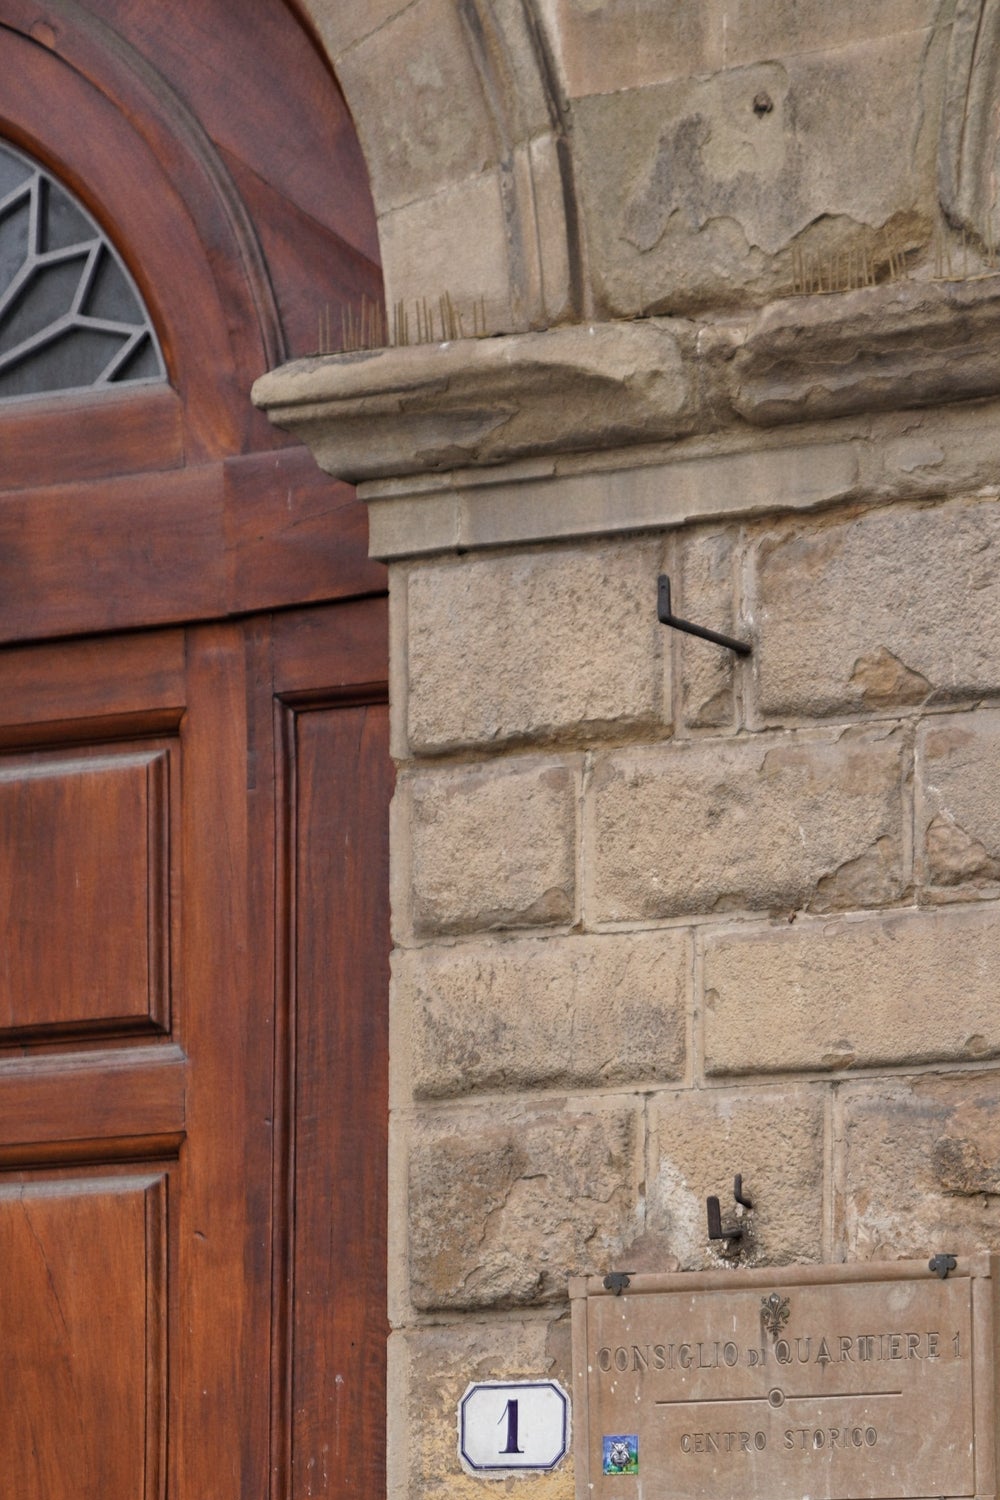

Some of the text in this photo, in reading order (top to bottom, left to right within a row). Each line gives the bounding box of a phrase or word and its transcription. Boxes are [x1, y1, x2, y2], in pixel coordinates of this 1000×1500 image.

[598, 1341, 739, 1372] CONSIGLIO
[774, 1331, 940, 1365] QUARTIERE
[952, 1330, 962, 1358] 1
[497, 1399, 525, 1454] 1
[680, 1426, 878, 1453] CENTRO STORICO
